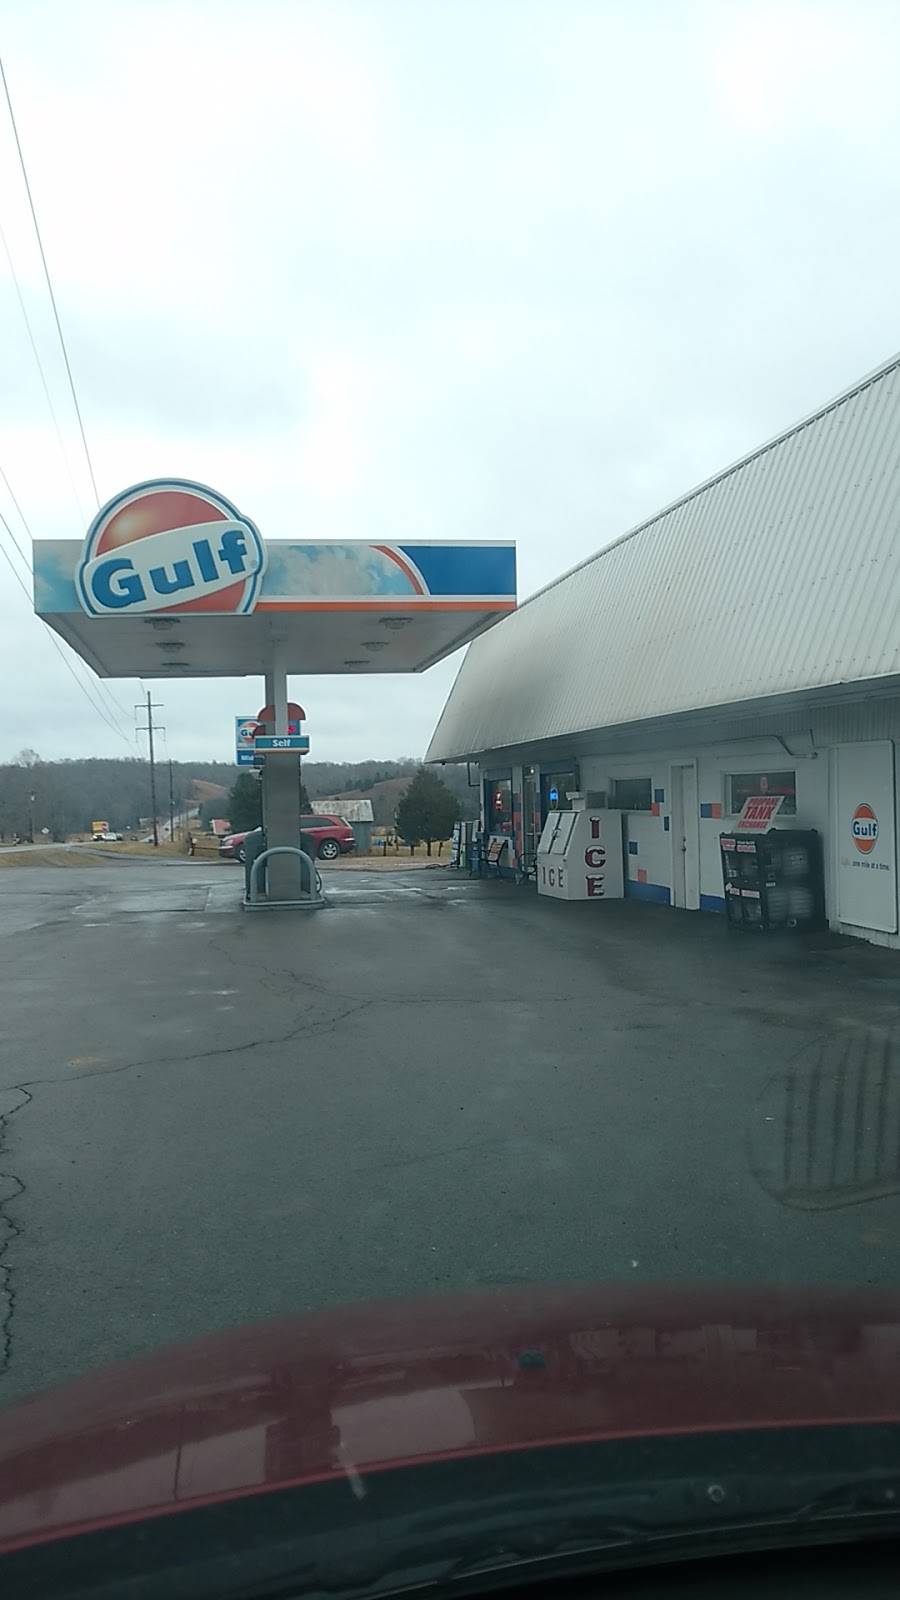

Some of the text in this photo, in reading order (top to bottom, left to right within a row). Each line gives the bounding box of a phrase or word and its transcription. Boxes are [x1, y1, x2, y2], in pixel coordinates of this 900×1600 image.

[91, 530, 248, 609] Gulf
[271, 739, 292, 748] Self
[743, 806, 776, 820] TANK
[852, 821, 878, 836] Gulf
[584, 816, 607, 897] ICE
[542, 866, 565, 888] ICE
